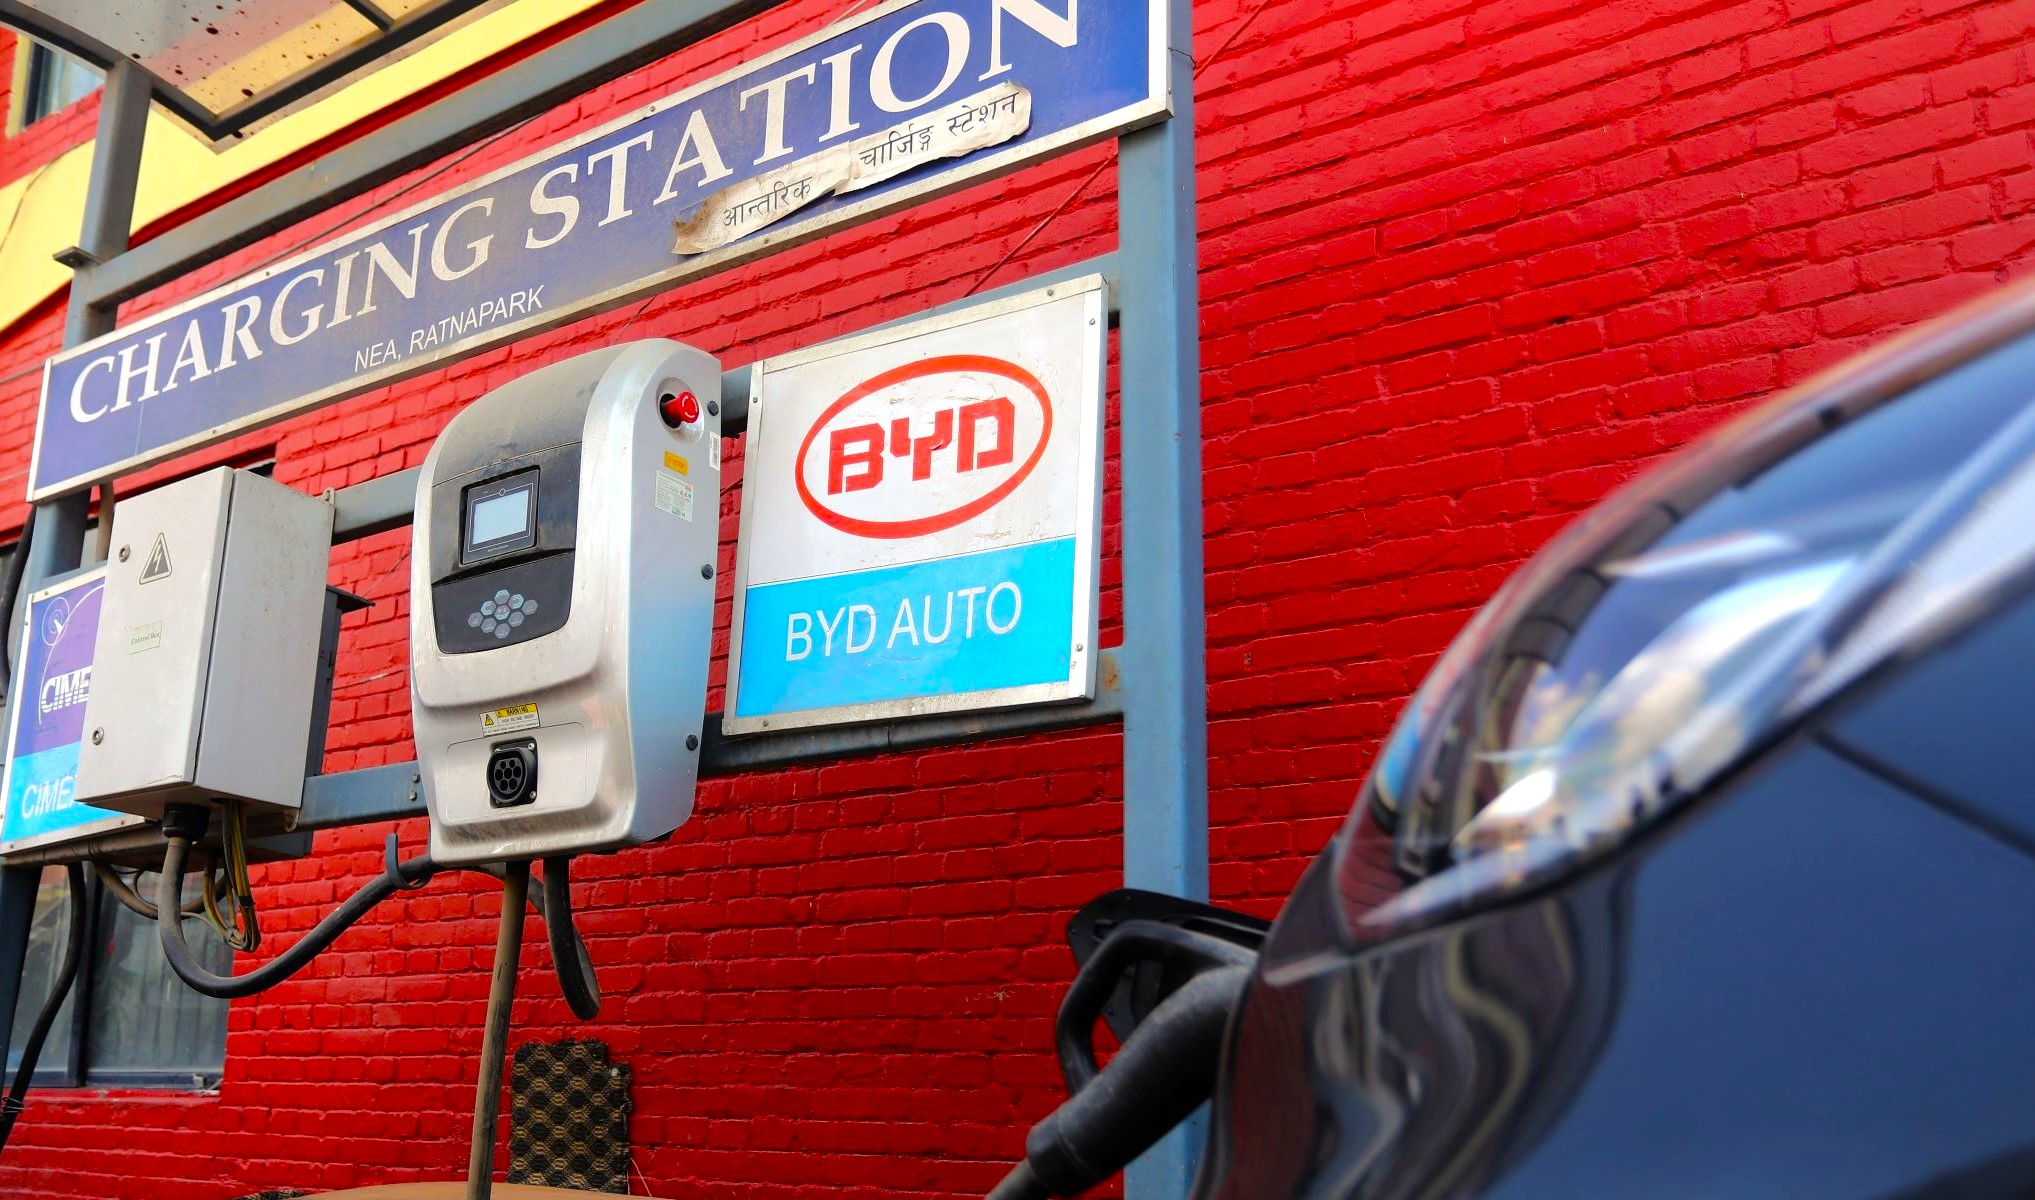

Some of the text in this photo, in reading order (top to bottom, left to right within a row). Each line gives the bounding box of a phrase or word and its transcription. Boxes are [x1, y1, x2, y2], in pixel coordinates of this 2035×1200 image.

[723, 176, 813, 227] आन्तरिक
[947, 92, 1020, 137] स्टेशन
[70, 0, 1077, 423] CHARGING STATION
[354, 284, 544, 373] NEA, RATNAPARK
[827, 396, 1015, 496] BYD
[786, 581, 1022, 663] BYD AUTO
[41, 665, 92, 713] CIME
[21, 775, 77, 820] CIME
